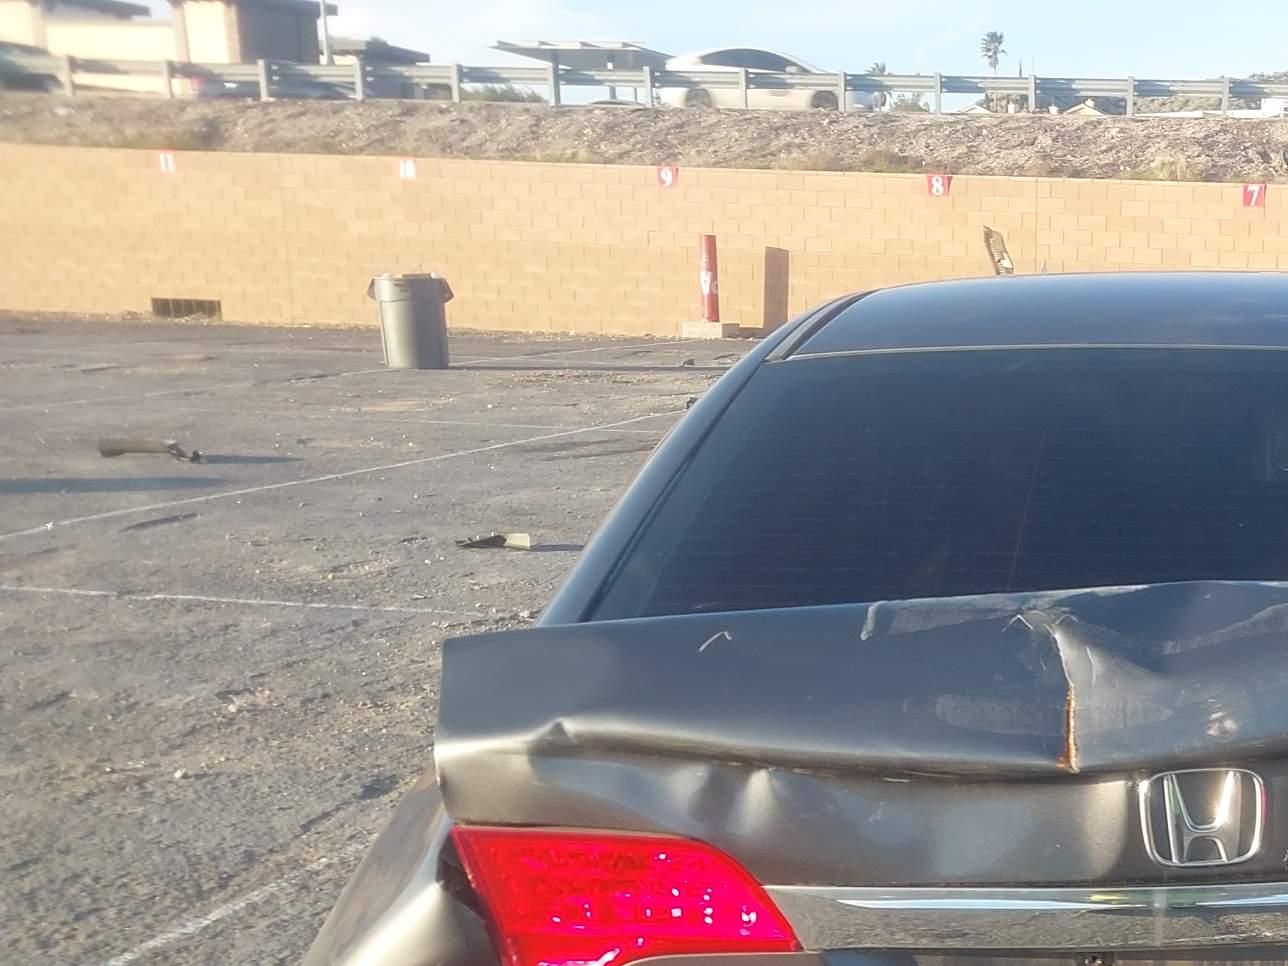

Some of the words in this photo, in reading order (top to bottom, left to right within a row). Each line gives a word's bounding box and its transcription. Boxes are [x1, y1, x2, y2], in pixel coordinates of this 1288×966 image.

[661, 168, 673, 188] 9
[931, 176, 945, 196] 8
[1247, 186, 1261, 206] 7
